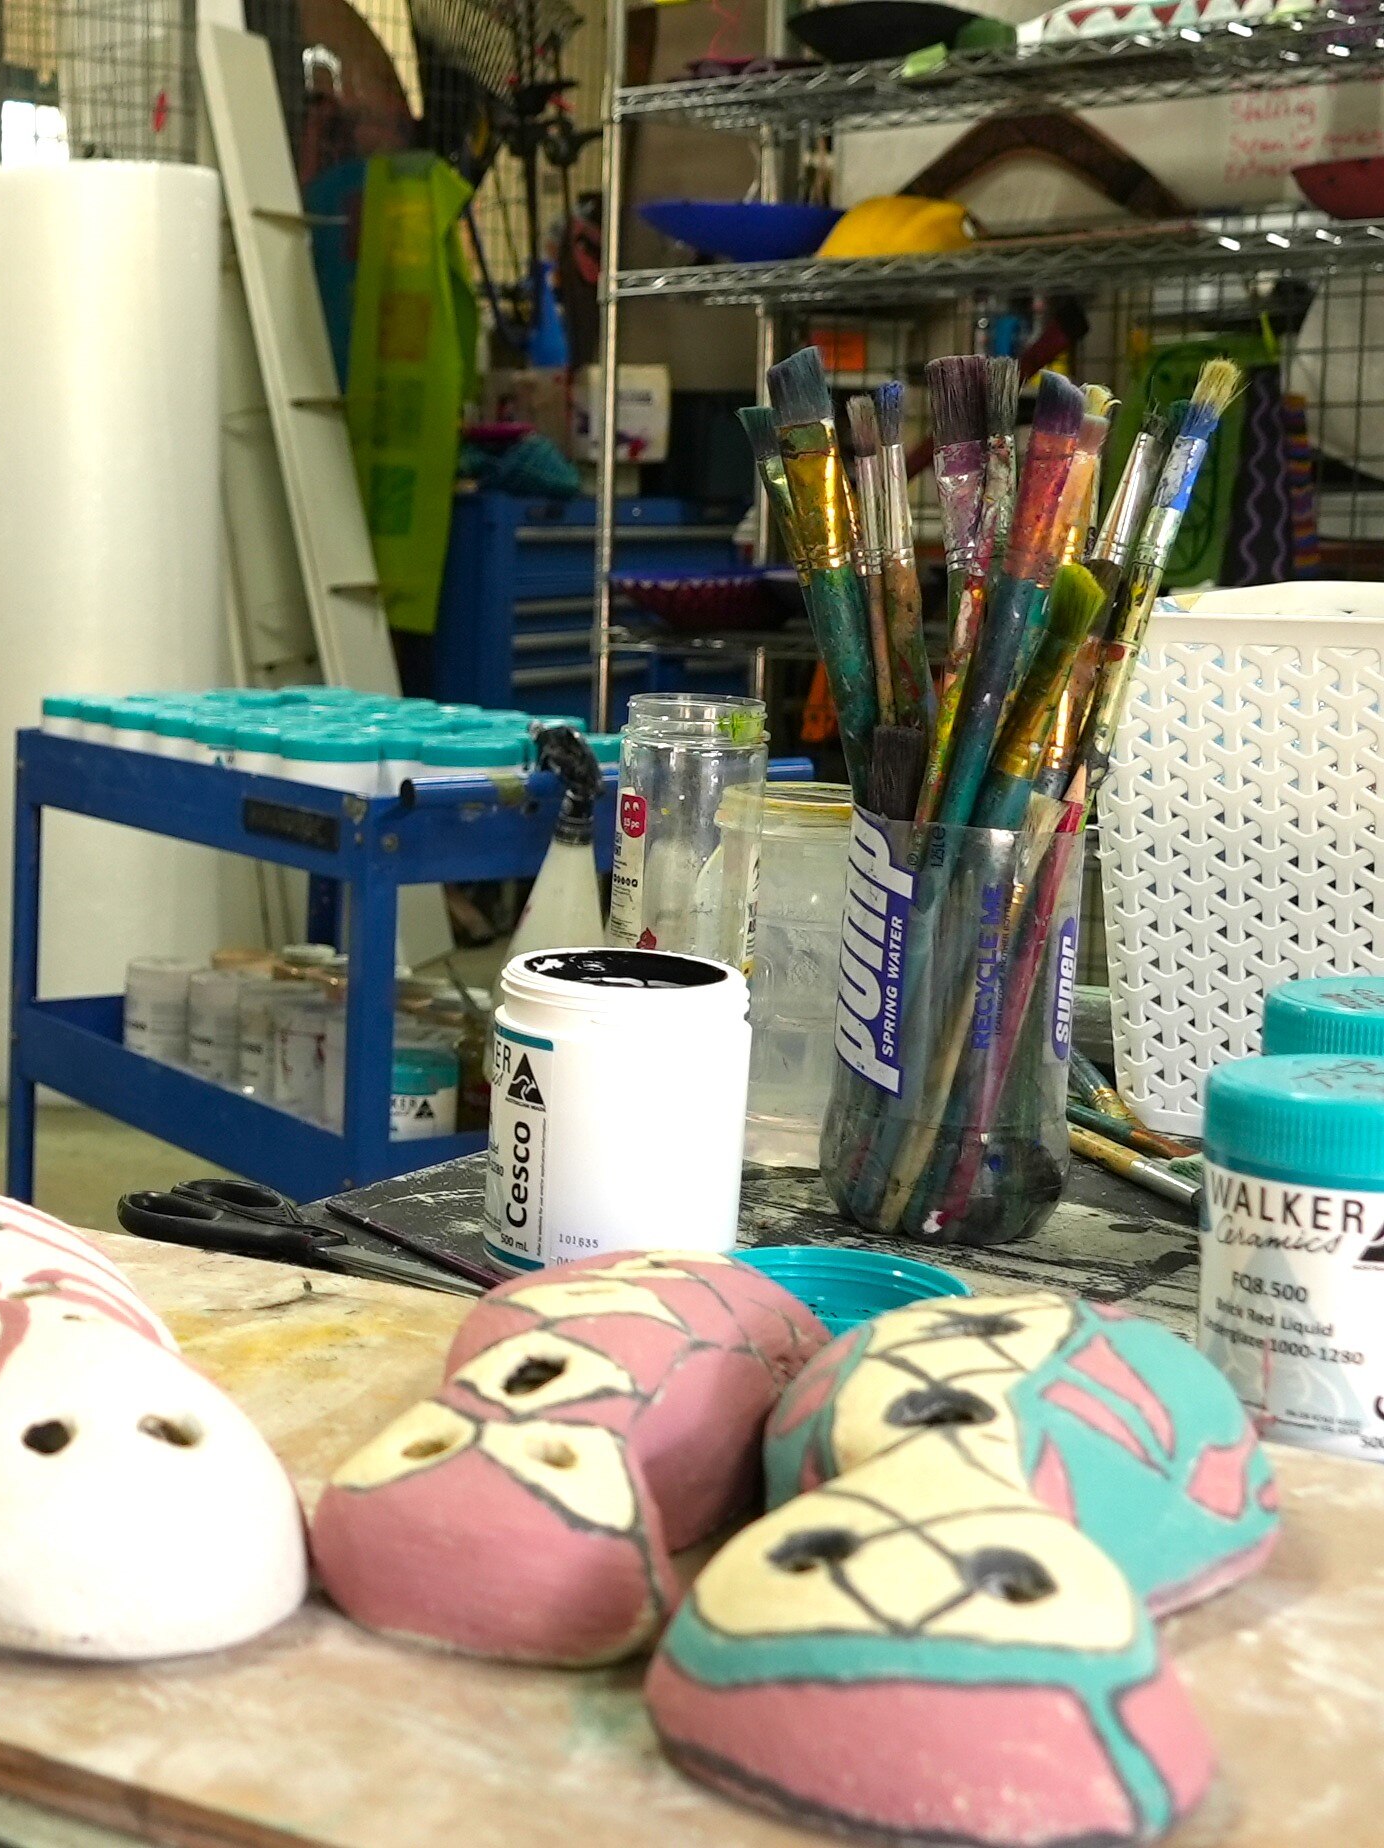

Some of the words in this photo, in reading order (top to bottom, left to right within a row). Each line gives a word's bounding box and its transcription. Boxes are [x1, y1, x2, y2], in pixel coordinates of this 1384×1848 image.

[980, 883, 1004, 925] ME
[834, 805, 914, 1094] pump
[887, 915, 904, 979] WATER
[882, 986, 899, 1057] SPRING
[971, 933, 999, 1050] RECYCLE
[1054, 935, 1075, 1044] super
[505, 1121, 531, 1228] Cesco
[1210, 1171, 1366, 1235] WALKER
[500, 1233, 514, 1247] 500
[515, 1241, 529, 1252] mL
[558, 1233, 599, 1249] 101635
[1216, 1213, 1344, 1254] Ceramics
[1246, 1308, 1276, 1327] Red
[1280, 1316, 1334, 1337] Liquid
